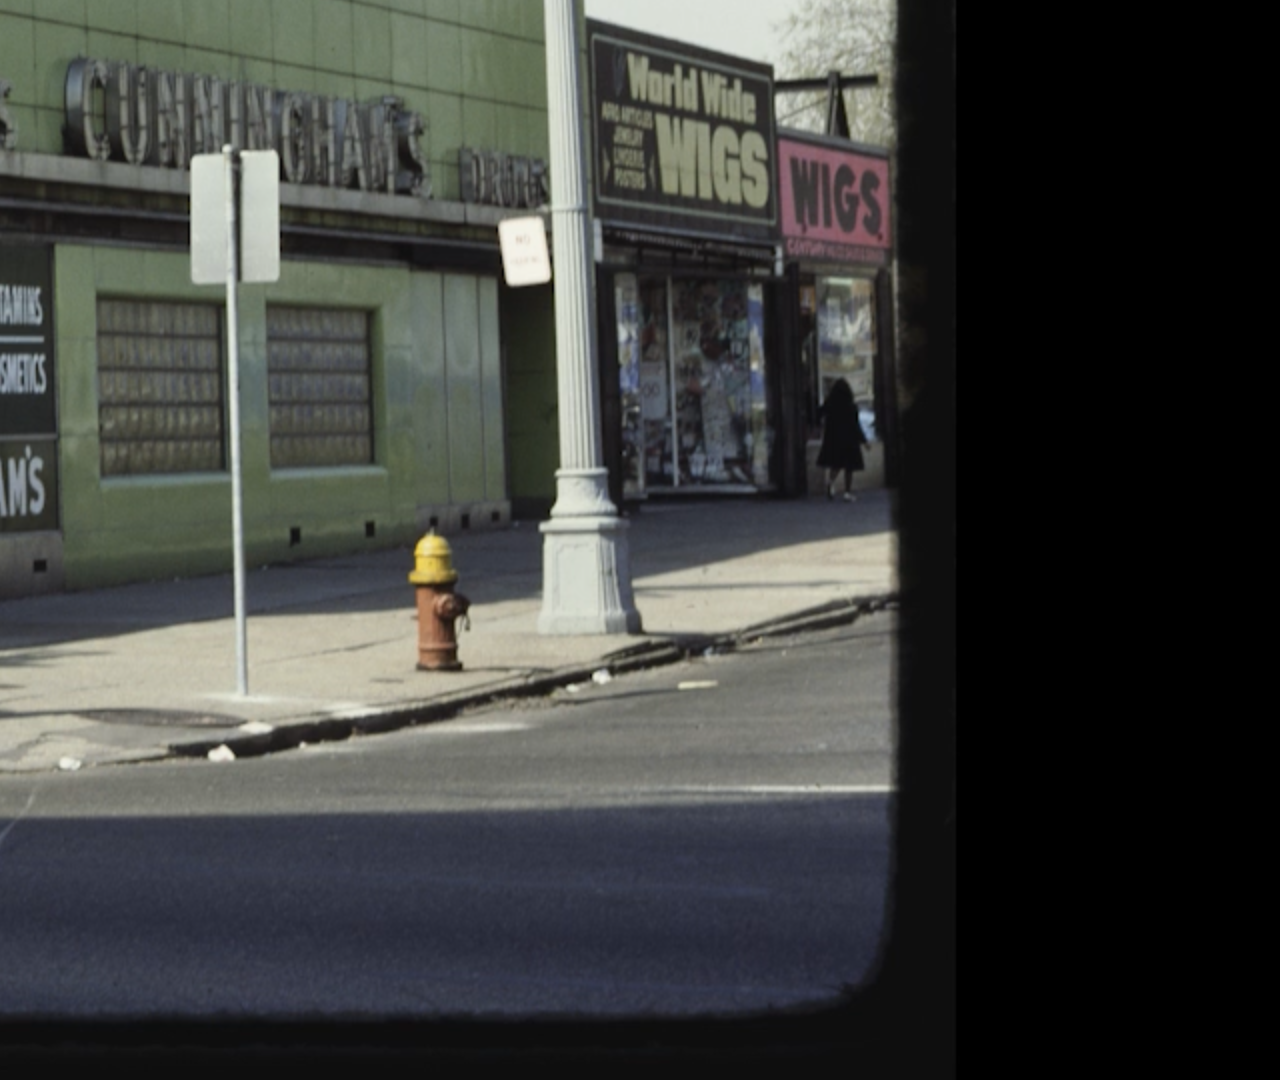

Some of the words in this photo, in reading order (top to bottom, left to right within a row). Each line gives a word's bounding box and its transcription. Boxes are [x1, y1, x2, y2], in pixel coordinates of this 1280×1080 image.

[627, 51, 699, 112] World
[701, 70, 757, 124] Wide
[655, 112, 769, 209] WIGS
[790, 155, 882, 236] WIGS
